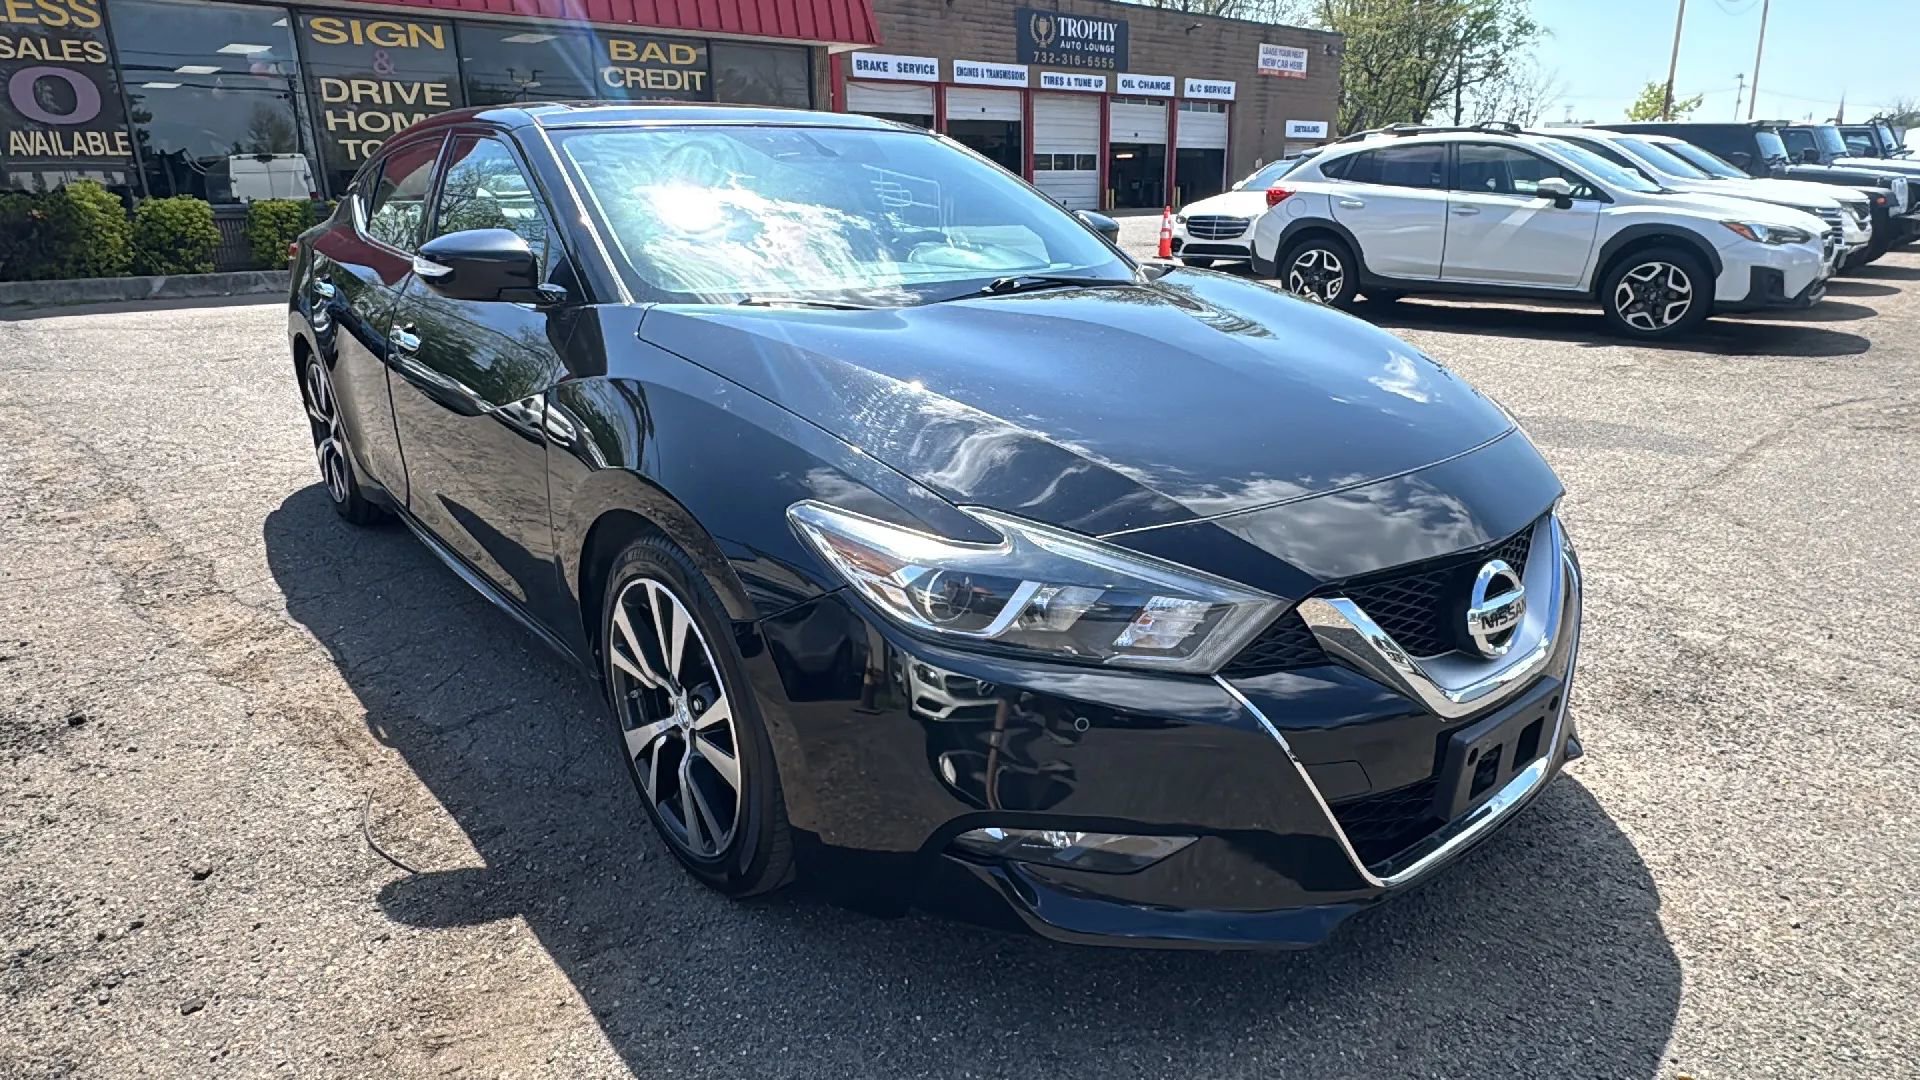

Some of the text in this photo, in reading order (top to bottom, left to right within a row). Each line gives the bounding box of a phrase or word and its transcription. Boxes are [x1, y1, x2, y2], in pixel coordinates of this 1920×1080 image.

[0, 0, 101, 28] ESS
[310, 17, 445, 49] SIGN
[1057, 17, 1118, 42] TROPHY
[0, 35, 107, 63] SALES
[609, 40, 697, 65] BAD
[1060, 40, 1115, 54] AUTO LOUNGE
[373, 50, 396, 74] &
[856, 59, 936, 75] BRAKE SERVICE
[956, 66, 979, 78] ENGINES
[986, 68, 1026, 81] TRANSMISSIONS
[1263, 58, 1276, 67] NEW
[1277, 59, 1289, 69] CAR
[603, 66, 706, 91] CREDIT
[1043, 76, 1104, 88] TIRES & TUNE UP
[1121, 79, 1171, 90] OIL CHANGE
[1190, 84, 1231, 94] A/C SERVICE
[320, 78, 450, 107] DRIVE
[325, 110, 437, 133] HOM
[10, 131, 132, 156] AVAILABLE
